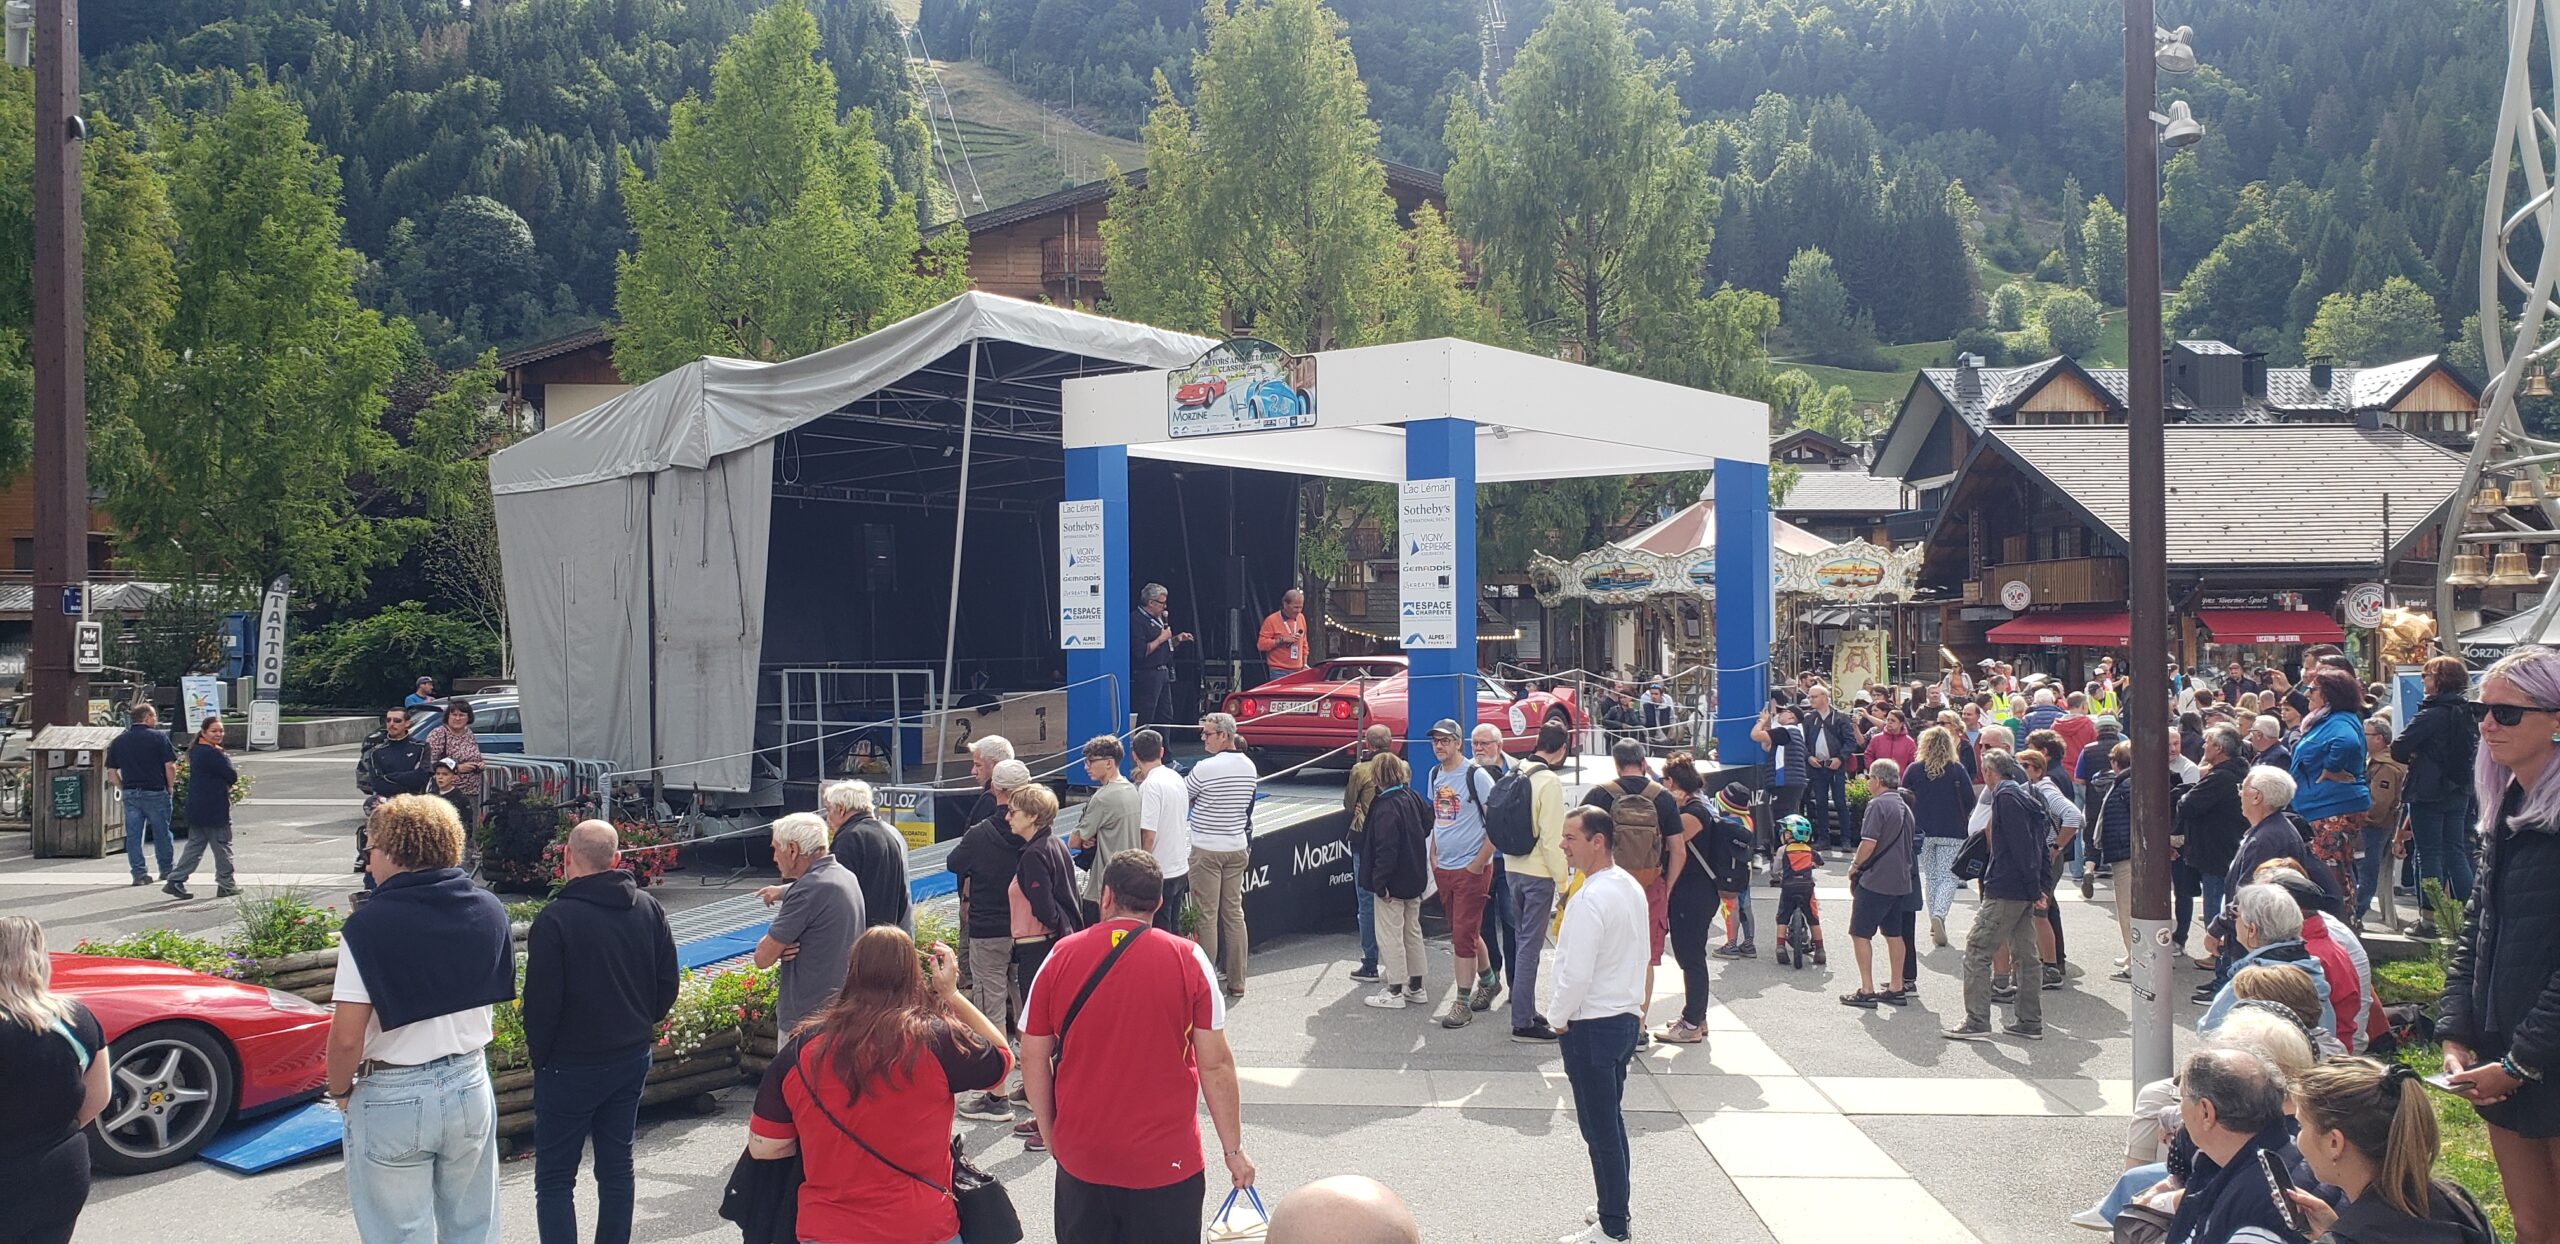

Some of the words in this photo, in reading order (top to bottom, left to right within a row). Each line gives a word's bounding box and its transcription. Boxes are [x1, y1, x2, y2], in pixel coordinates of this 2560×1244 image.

[1172, 410, 1208, 423] MORZINE
[1403, 484, 1419, 495] Lac
[1421, 482, 1451, 493] Léman
[1063, 505, 1075, 513] Lac
[1076, 503, 1100, 512] Léman
[1404, 503, 1451, 516] Sotheby's
[1063, 521, 1100, 533] Sotheby's
[1420, 533, 1444, 542] VIGNY
[1421, 541, 1452, 551] DEPIERRE
[1073, 607, 1101, 615] ESPACE
[1415, 601, 1452, 610] ESPACE
[263, 594, 284, 685] TATTOO
[953, 717, 972, 754] 2
[1034, 706, 1047, 742] 1
[1329, 871, 1354, 887] Portes
